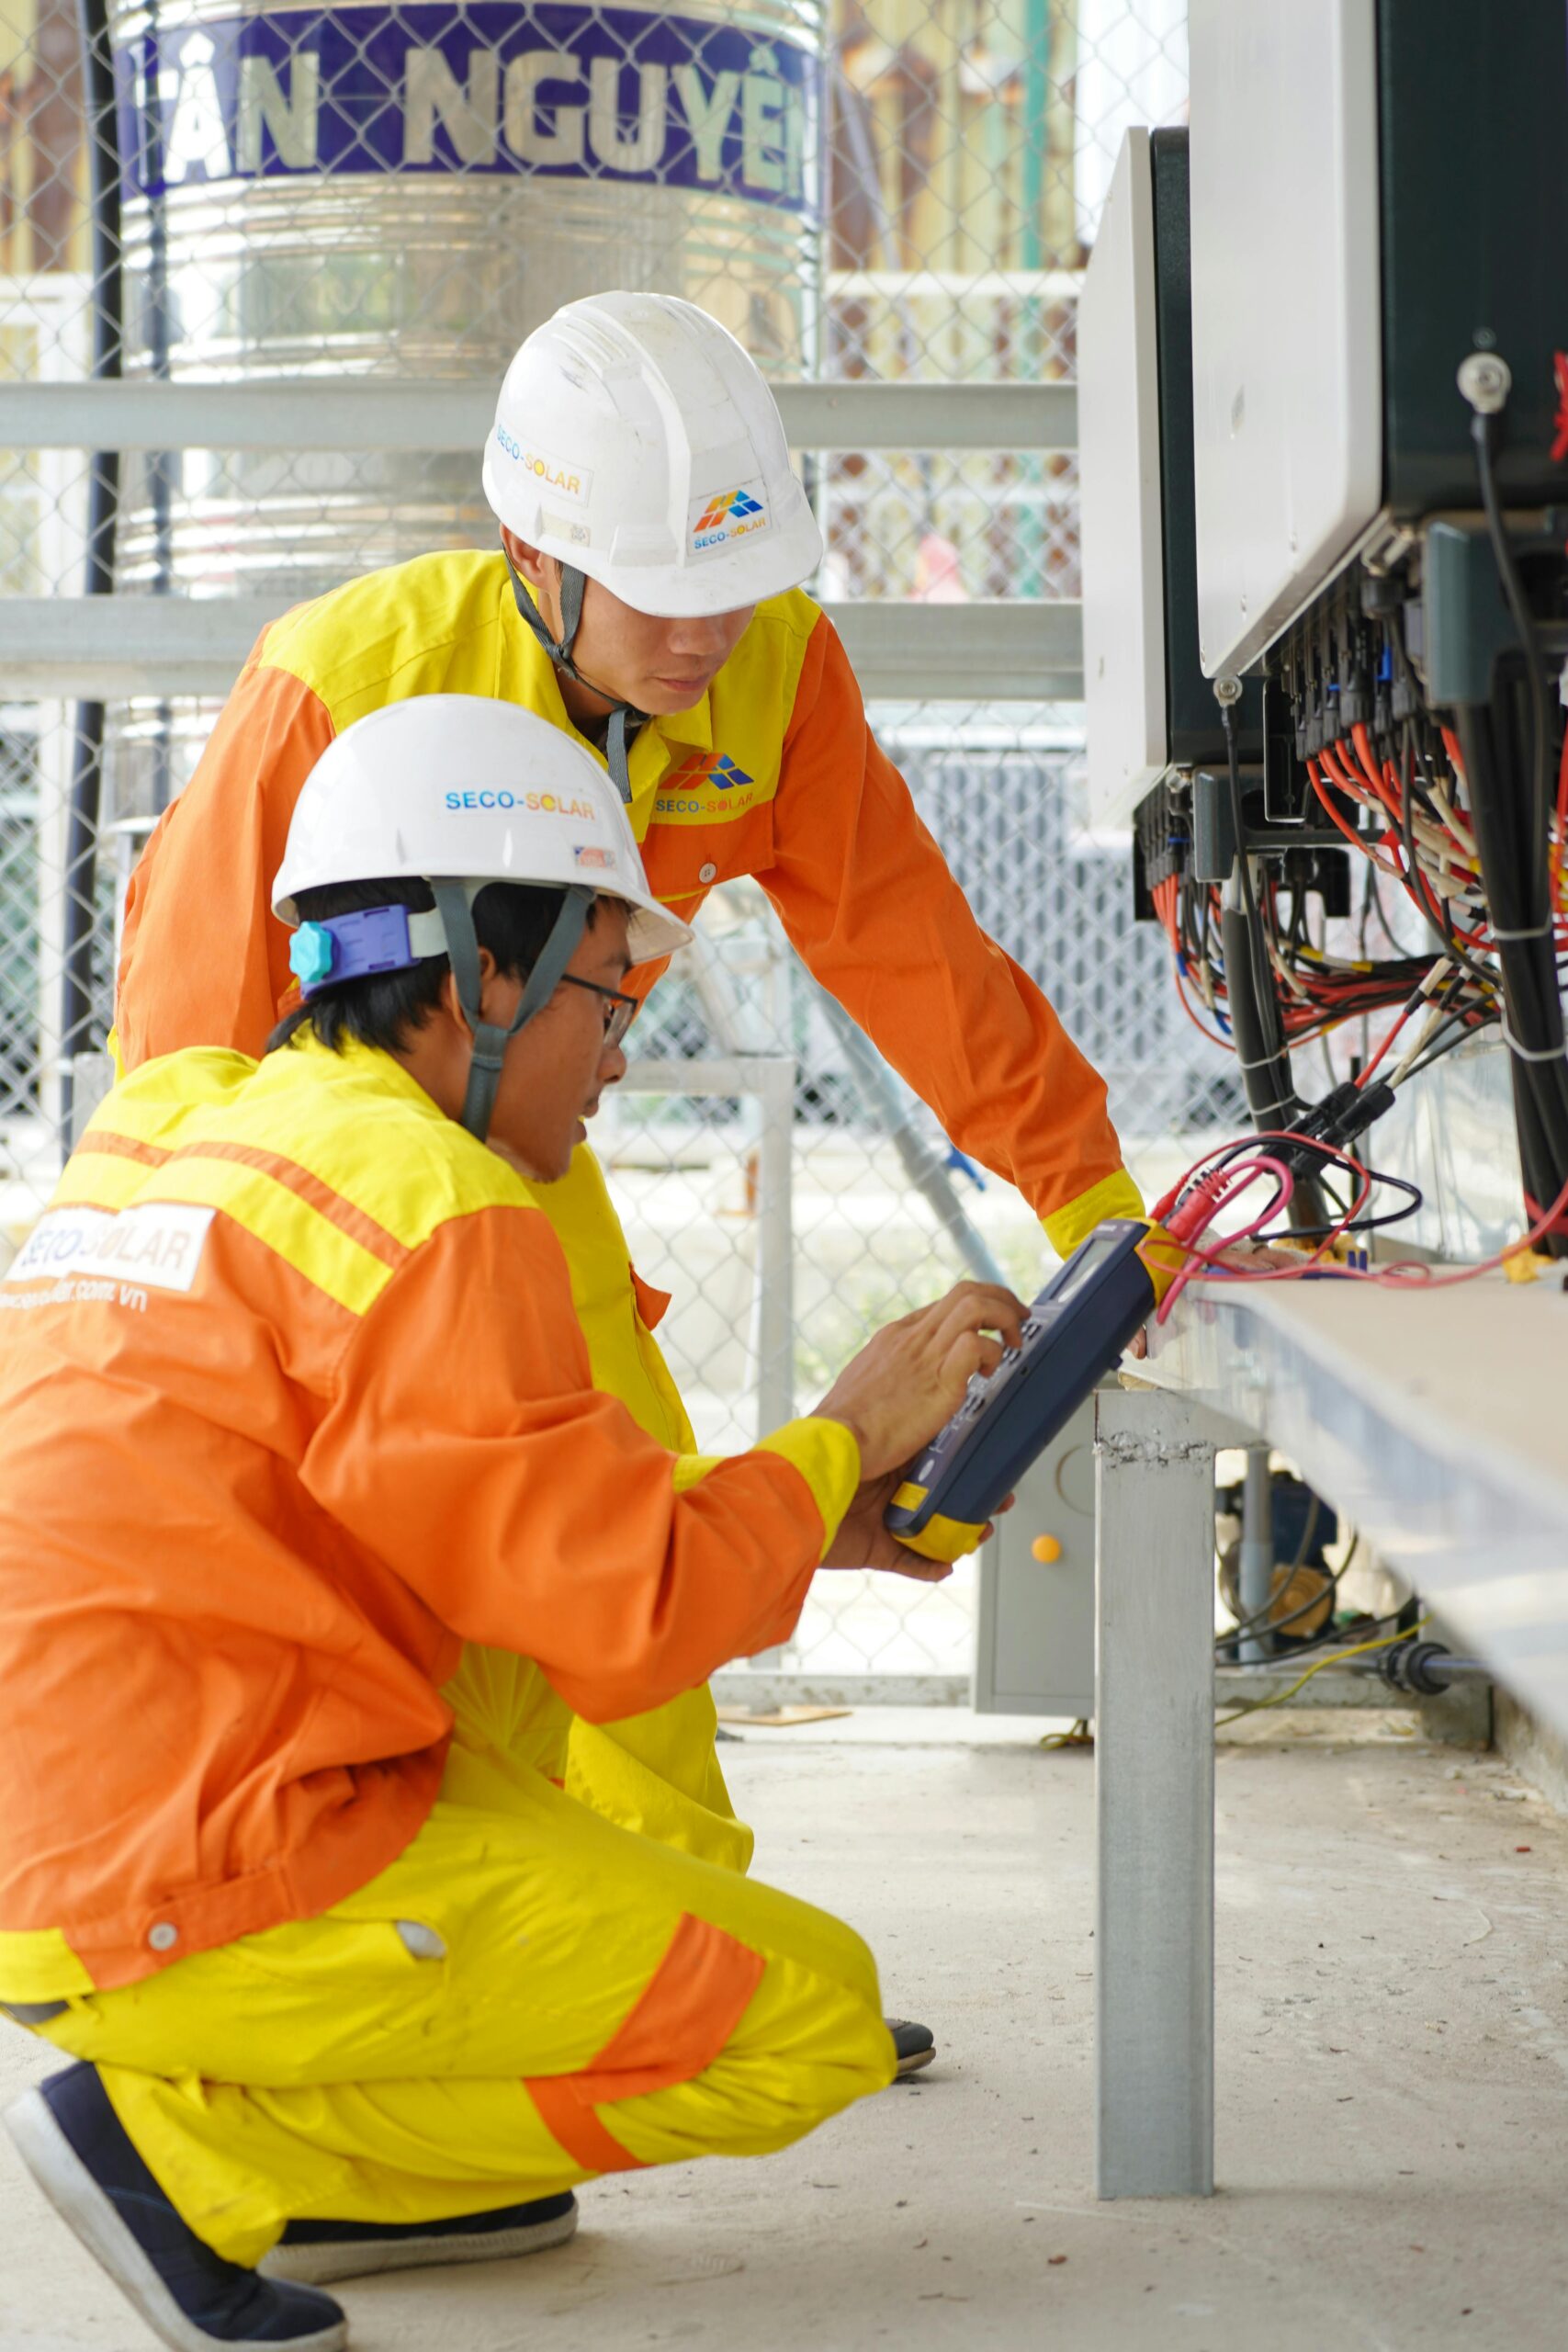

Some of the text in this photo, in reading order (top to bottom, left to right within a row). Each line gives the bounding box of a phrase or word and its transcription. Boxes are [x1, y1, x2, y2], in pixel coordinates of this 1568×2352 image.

[497, 424, 581, 494] SECO-SOLAR
[694, 517, 767, 549] SECO-SOLAR
[446, 791, 595, 820] SECO-SOLAR
[656, 793, 753, 813] SECO-SOLAR
